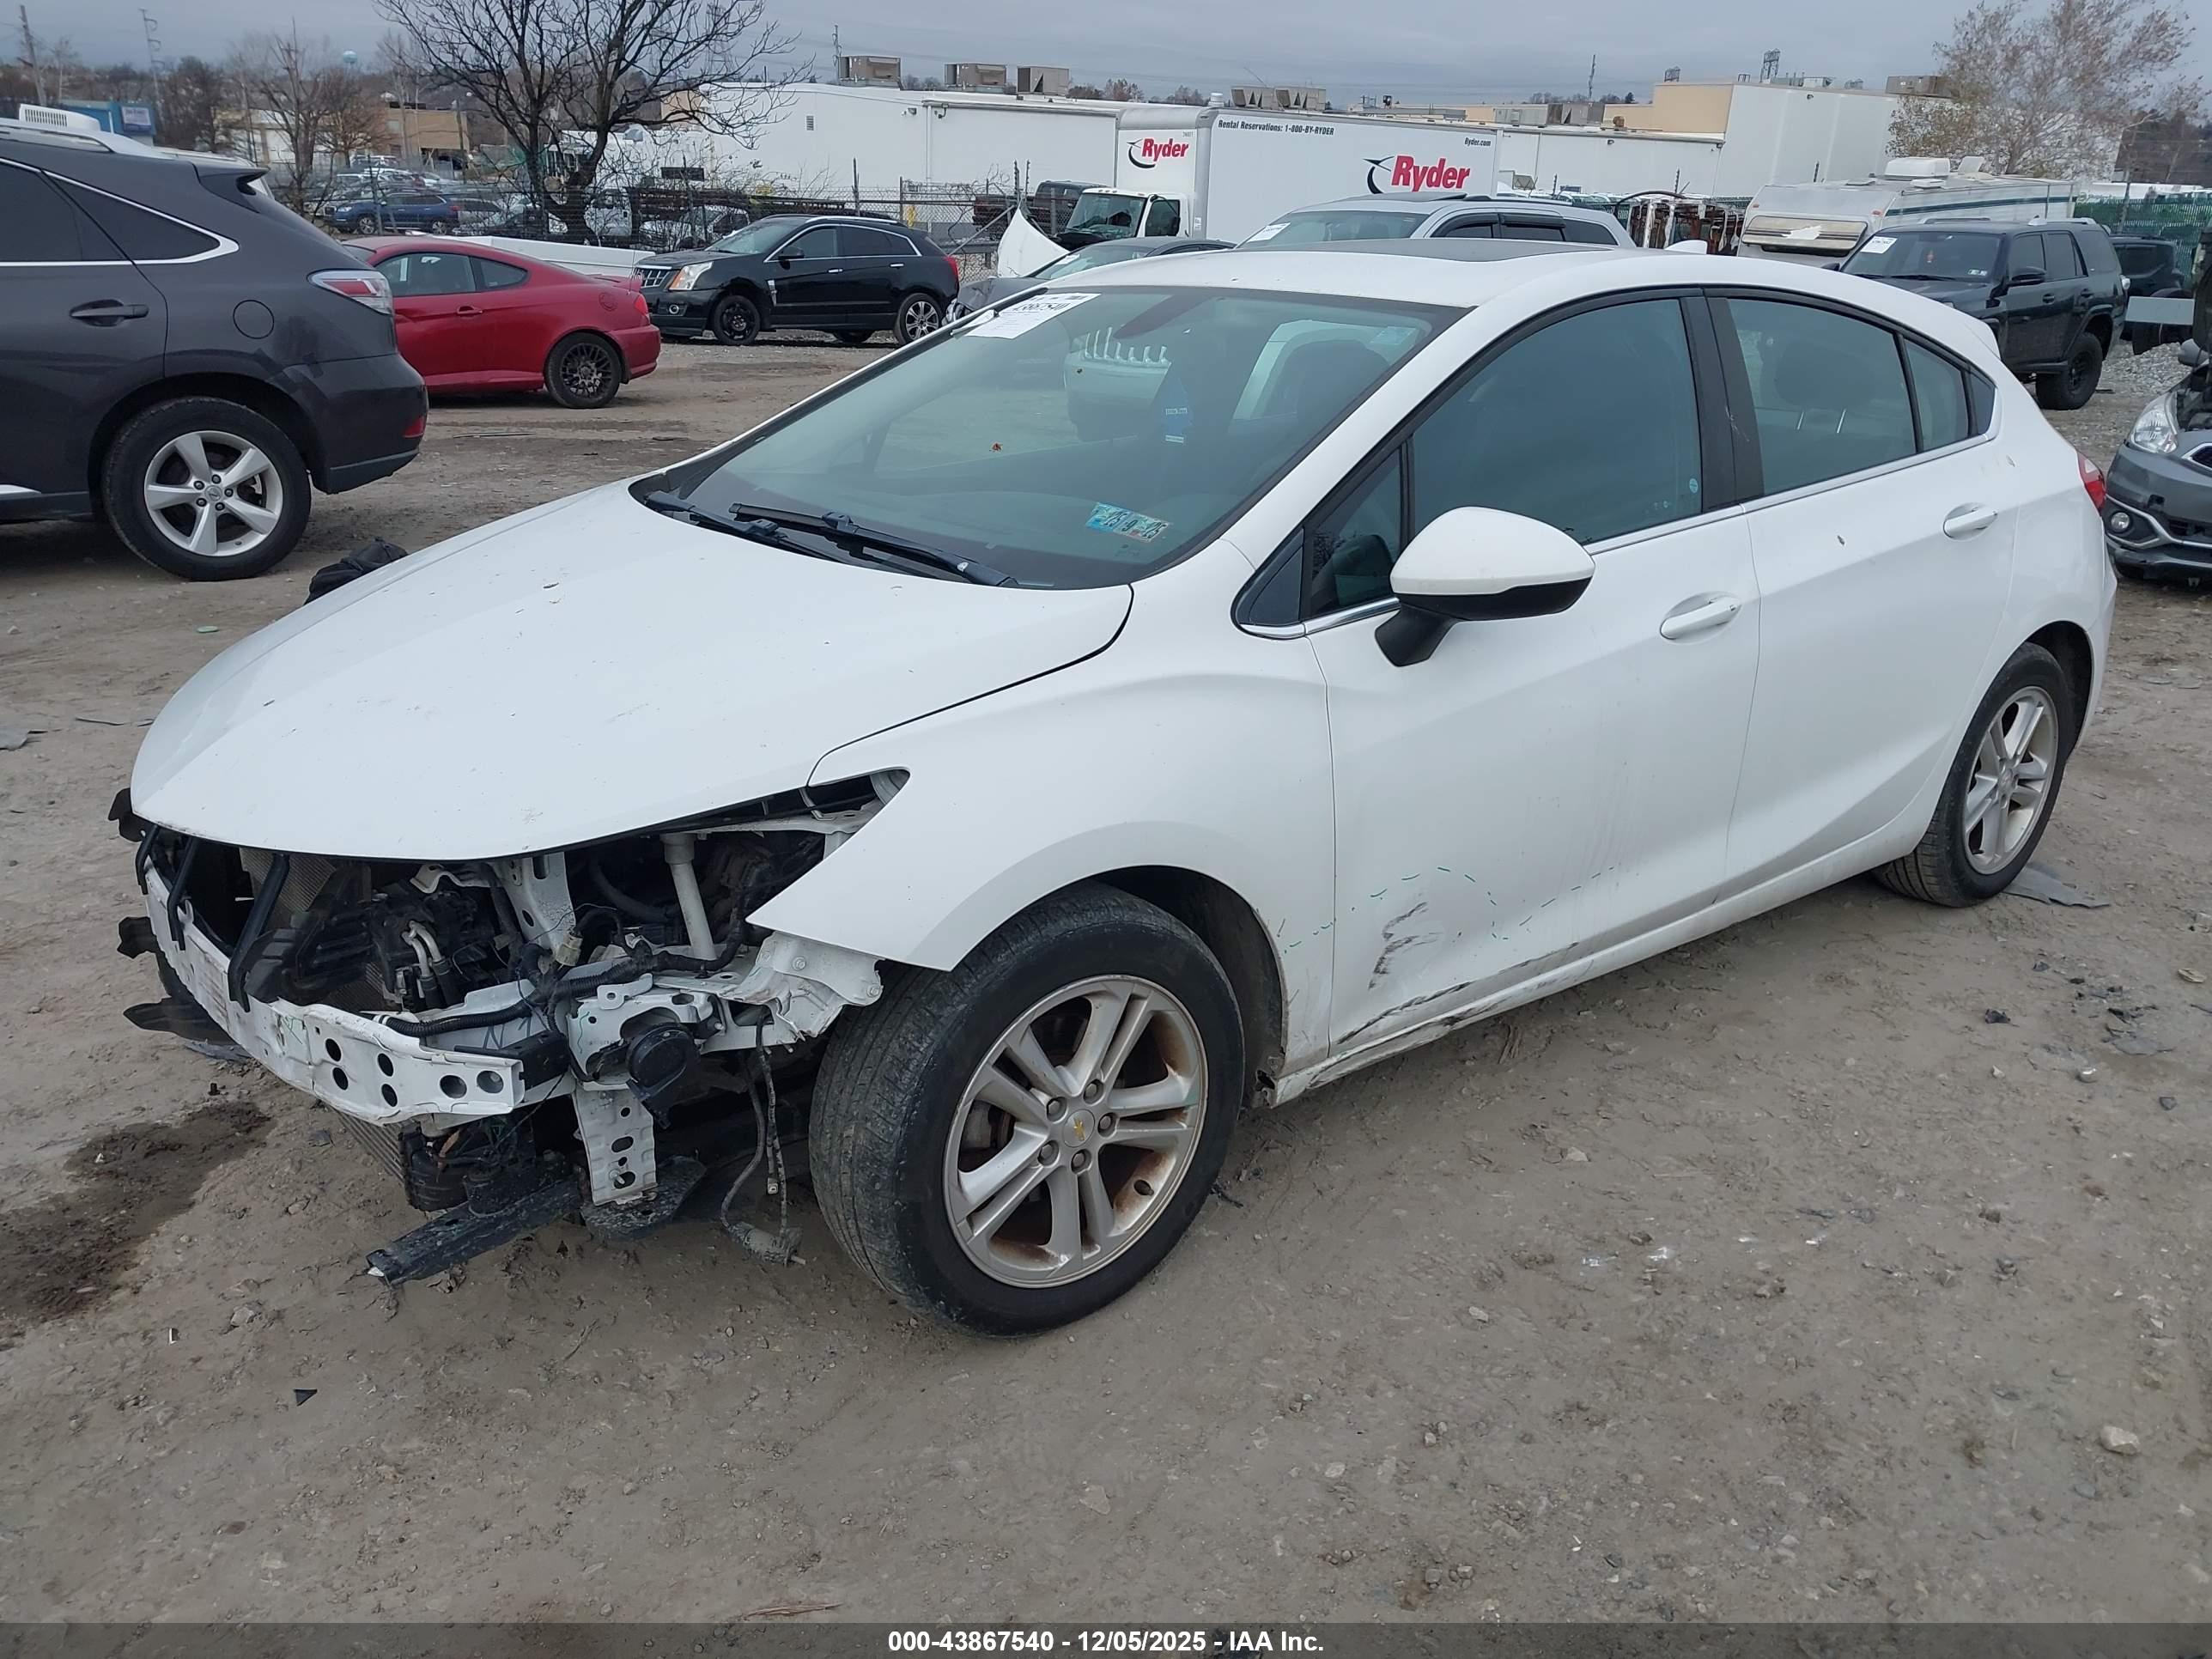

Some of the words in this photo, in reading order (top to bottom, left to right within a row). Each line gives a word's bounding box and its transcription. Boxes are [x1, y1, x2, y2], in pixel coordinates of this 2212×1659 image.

[1218, 119, 1239, 130] Rental
[1241, 121, 1283, 132] Reservations:
[1285, 124, 1334, 136] 1-800-BY-RYDER
[1141, 138, 1189, 162] Ryder
[1464, 137, 1492, 147] Ryder.com
[1391, 155, 1471, 192] Ryder
